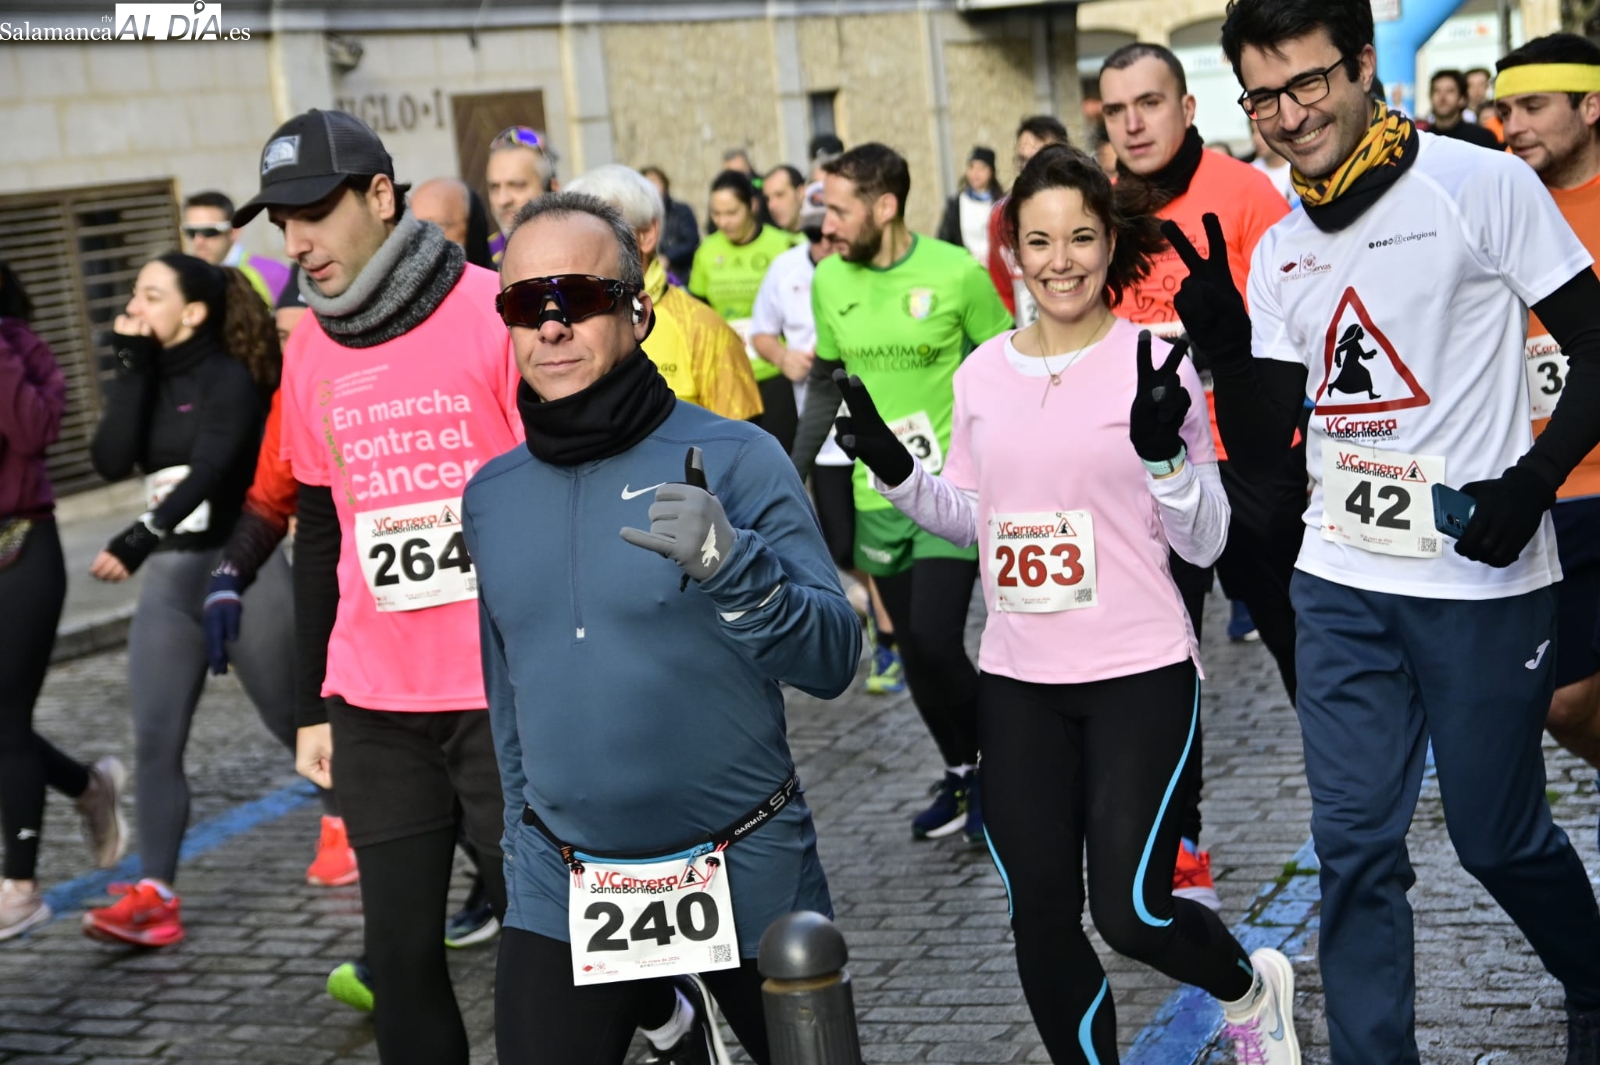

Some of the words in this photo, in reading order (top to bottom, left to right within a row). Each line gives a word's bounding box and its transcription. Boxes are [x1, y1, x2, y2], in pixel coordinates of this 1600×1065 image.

[332, 406, 362, 431] En
[367, 389, 472, 423] marcha
[342, 427, 435, 464] contra
[438, 420, 474, 450] el
[1322, 426, 1393, 438] ntaBonifacia
[352, 458, 479, 501] cáncer
[1335, 461, 1398, 480] SantaBonifacia
[1345, 480, 1411, 531] 42
[368, 531, 473, 587] 264
[995, 543, 1085, 587] 263
[734, 809, 768, 836] GARMIN
[590, 883, 674, 895] SantaBonifacia
[583, 891, 720, 953] 240
